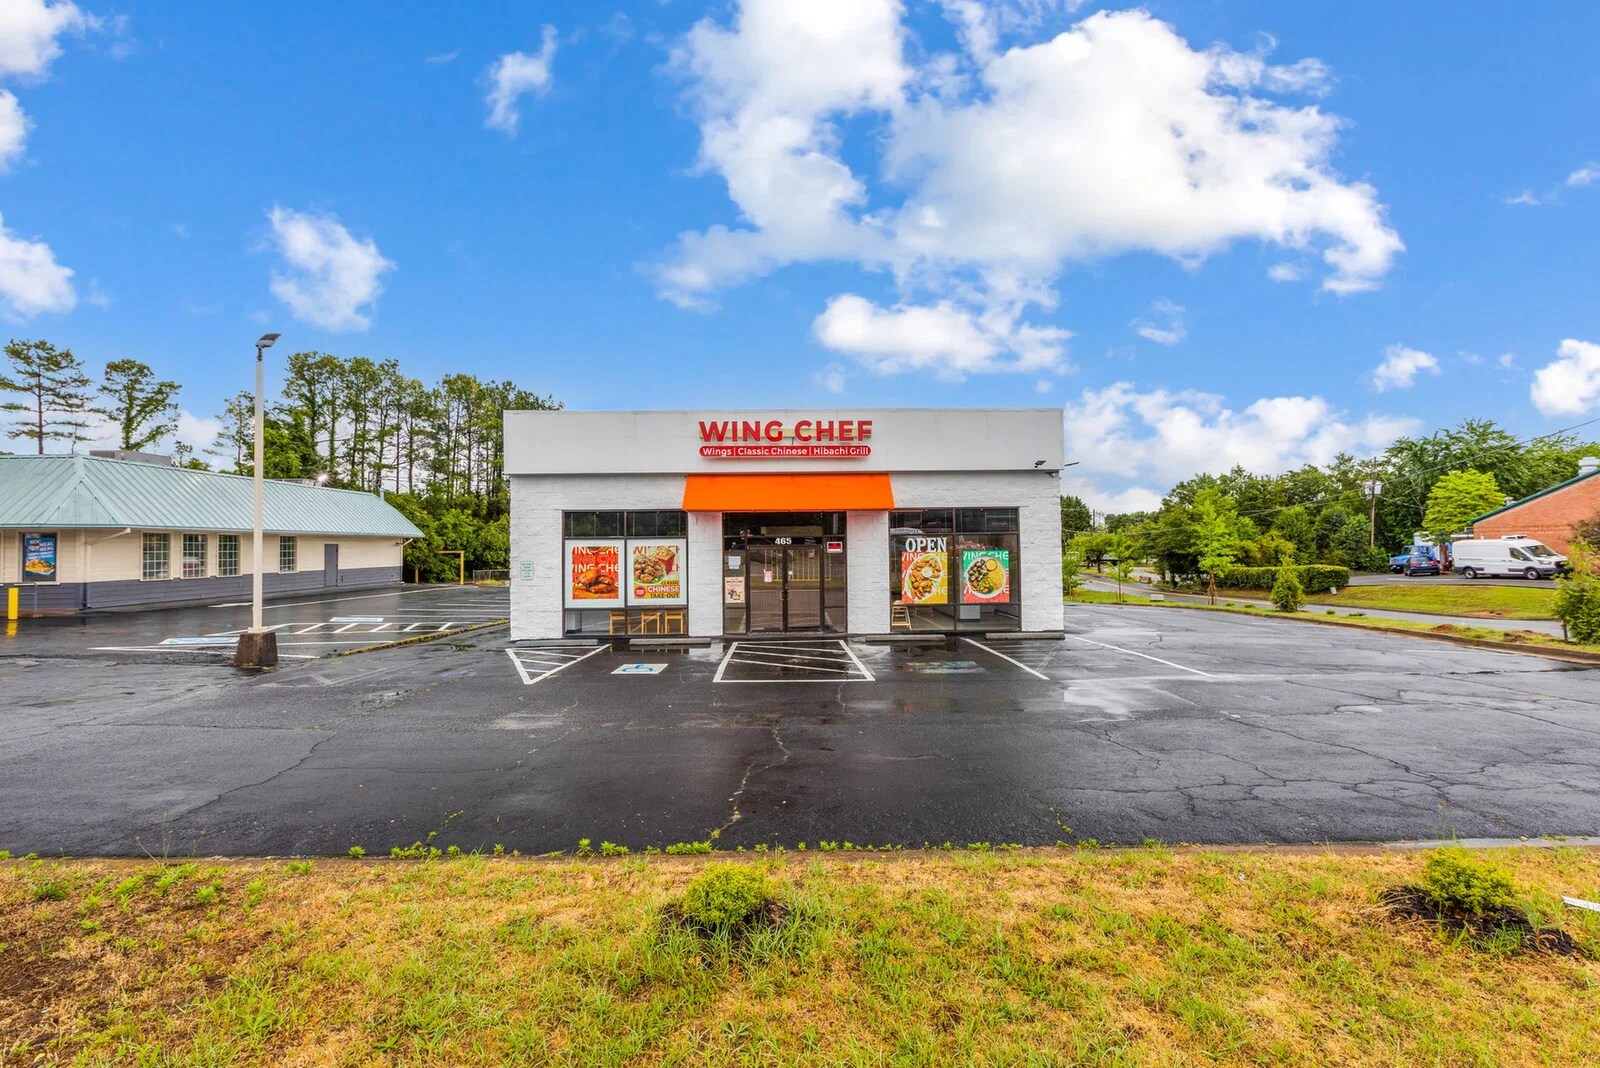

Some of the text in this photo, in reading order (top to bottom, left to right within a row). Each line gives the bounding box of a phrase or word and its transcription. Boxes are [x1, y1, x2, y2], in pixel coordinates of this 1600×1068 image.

[698, 420, 873, 443] WING CHEF
[703, 447, 869, 457] Wings Classic Chinese Hibachi Grill
[774, 537, 792, 545] 465
[905, 537, 947, 552] OPEN
